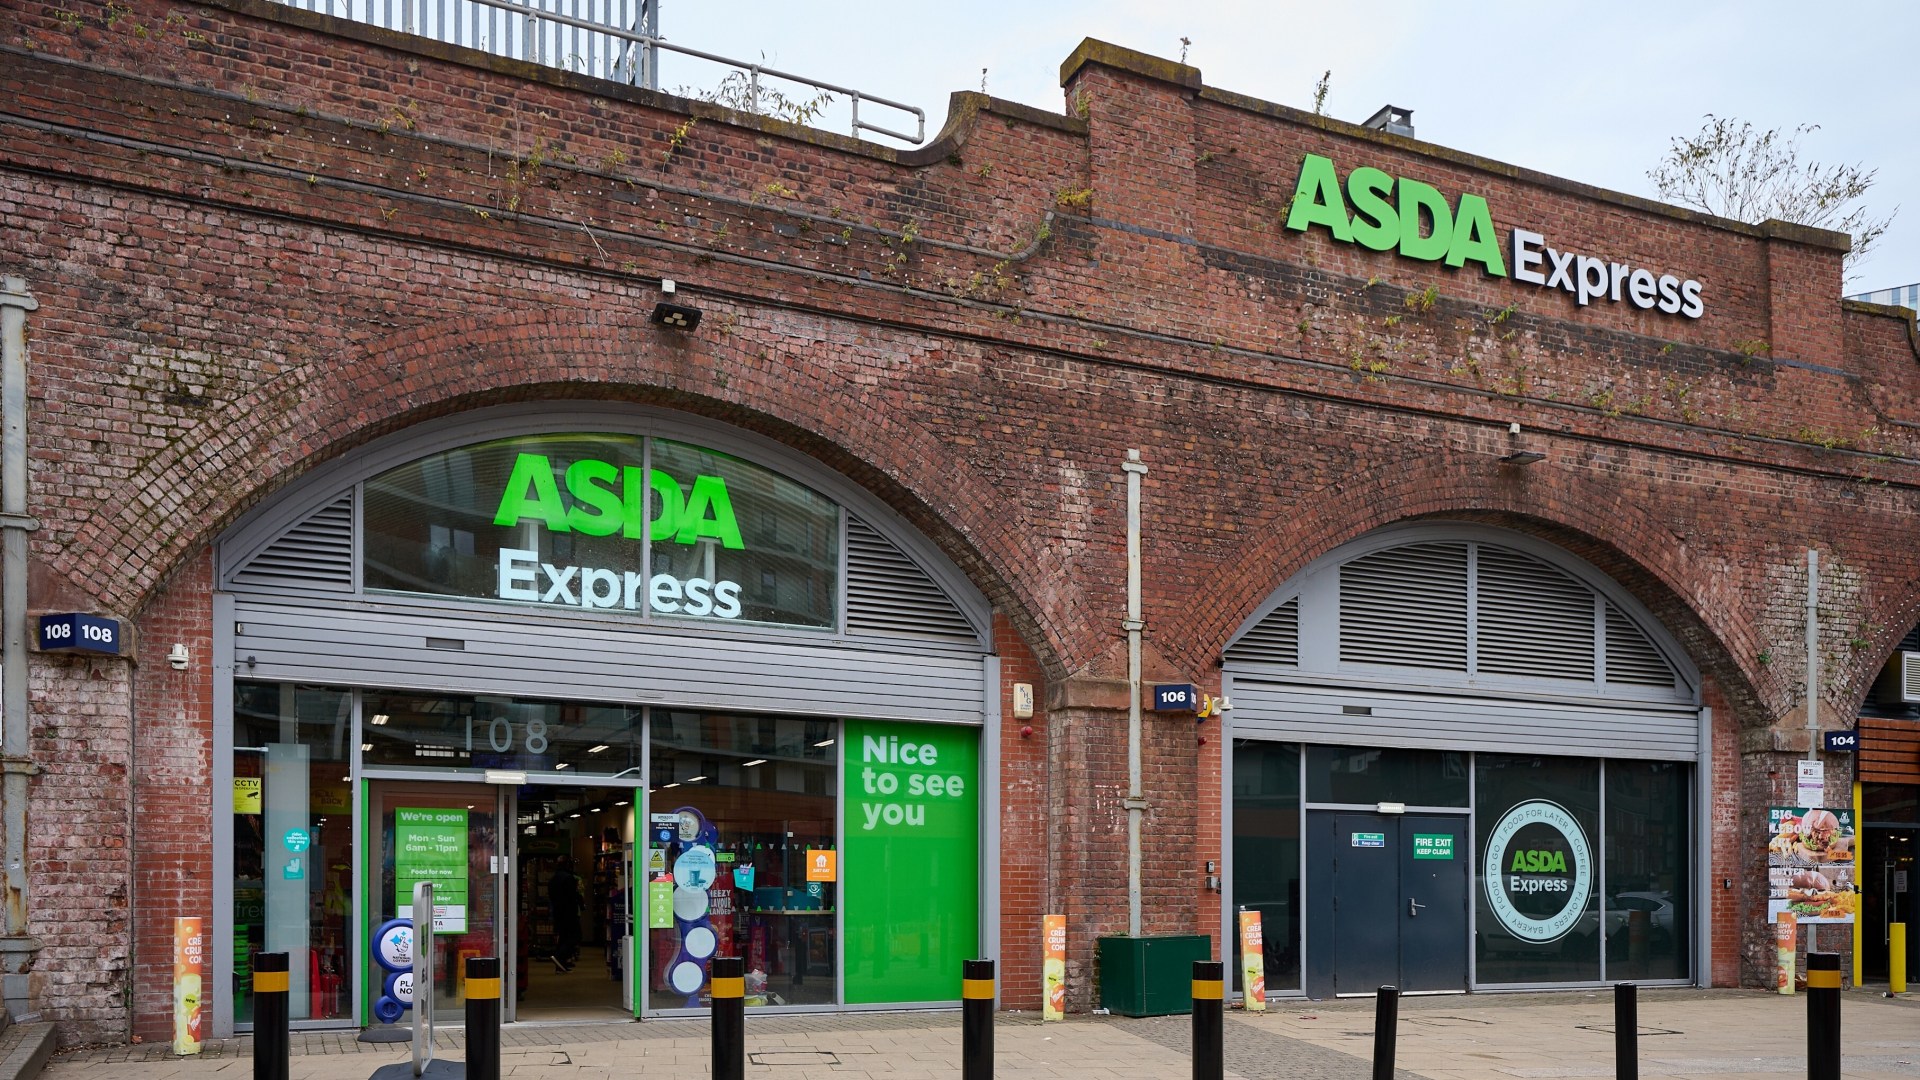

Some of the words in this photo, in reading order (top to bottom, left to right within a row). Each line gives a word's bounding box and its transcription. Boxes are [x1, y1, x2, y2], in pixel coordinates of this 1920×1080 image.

[1286, 153, 1507, 277] ASDA
[1511, 228, 1704, 319] Express
[493, 453, 745, 550] ASDA
[499, 547, 742, 619] Express
[45, 624, 71, 639] 108
[82, 624, 112, 643] 108
[1161, 691, 1186, 702] 106
[466, 716, 548, 754] 108
[1831, 736, 1855, 746] 104
[863, 735, 938, 766] Nice
[862, 767, 899, 795] to
[908, 773, 965, 797] see
[400, 812, 433, 822] We're
[436, 814, 464, 822] open
[862, 803, 925, 831] you
[1503, 813, 1524, 835] FOOD
[1525, 809, 1542, 818] FOR
[1544, 810, 1569, 830] LATER
[1772, 810, 1792, 820] BIG
[437, 834, 456, 842] Sun
[1416, 838, 1432, 846] FIRE
[1435, 838, 1452, 846] EXIT
[435, 844, 458, 853] 11pm
[1493, 844, 1501, 860] GO
[1574, 838, 1586, 877] COFFEE
[1510, 850, 1568, 872] ASDA
[1490, 864, 1497, 878] TO
[1510, 876, 1568, 894] Express
[711, 897, 731, 908] LAVOUR
[1492, 882, 1506, 910] FOOD
[1554, 892, 1583, 930] FLOWERS
[1512, 918, 1544, 934] BAKERY
